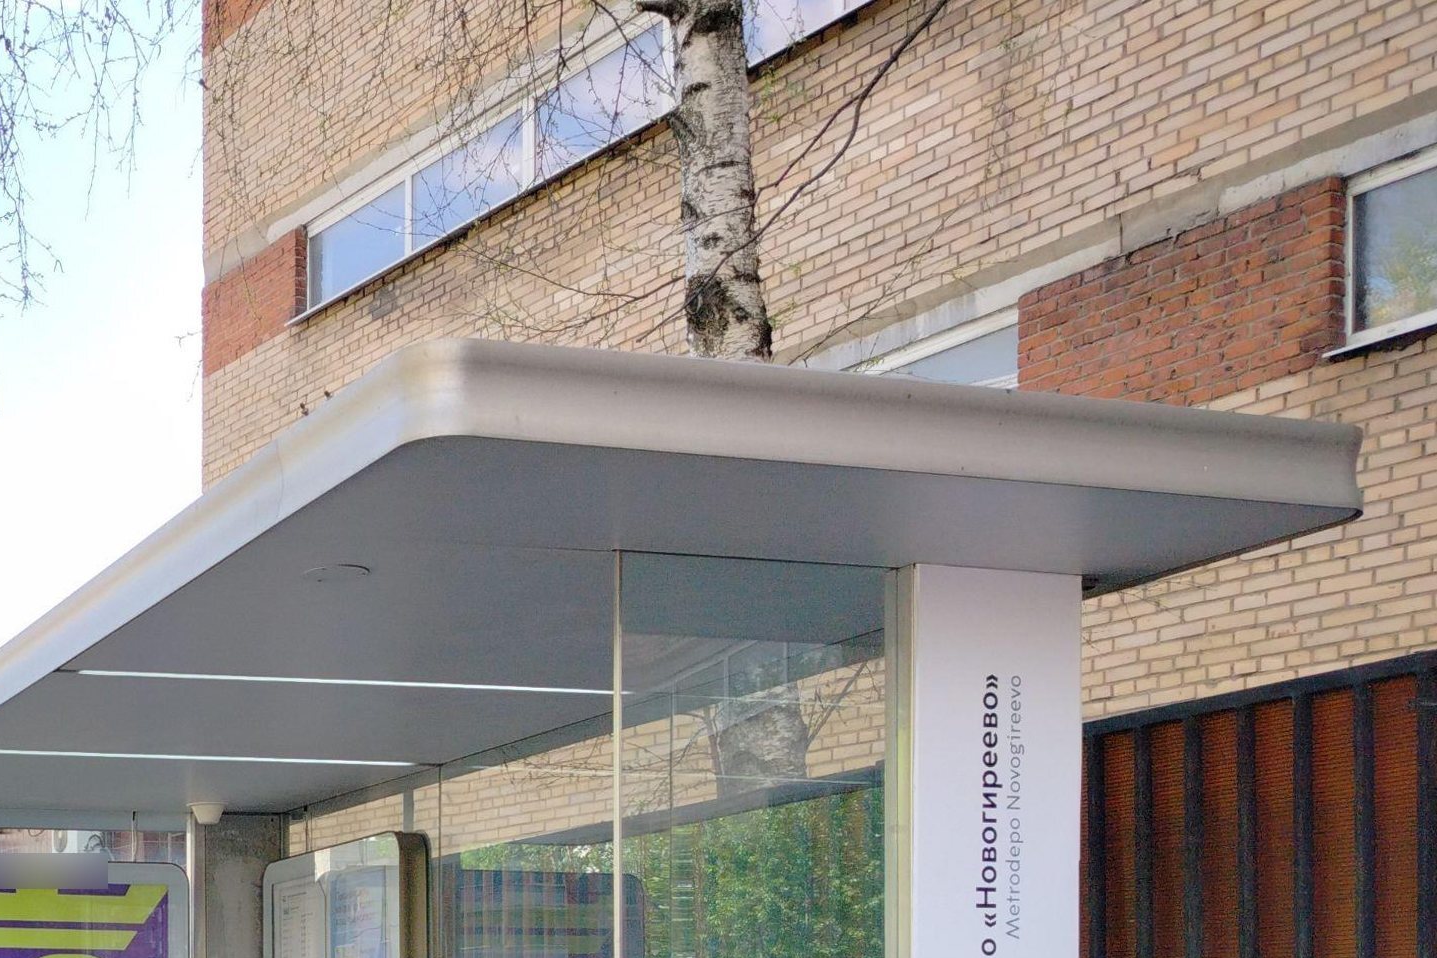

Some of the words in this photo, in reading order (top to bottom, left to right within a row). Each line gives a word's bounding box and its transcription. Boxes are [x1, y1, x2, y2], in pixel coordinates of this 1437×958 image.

[976, 673, 1003, 928] «Новогиреево»
[1007, 675, 1025, 811] Novogireevo
[1005, 817, 1024, 940] Metrodepo
